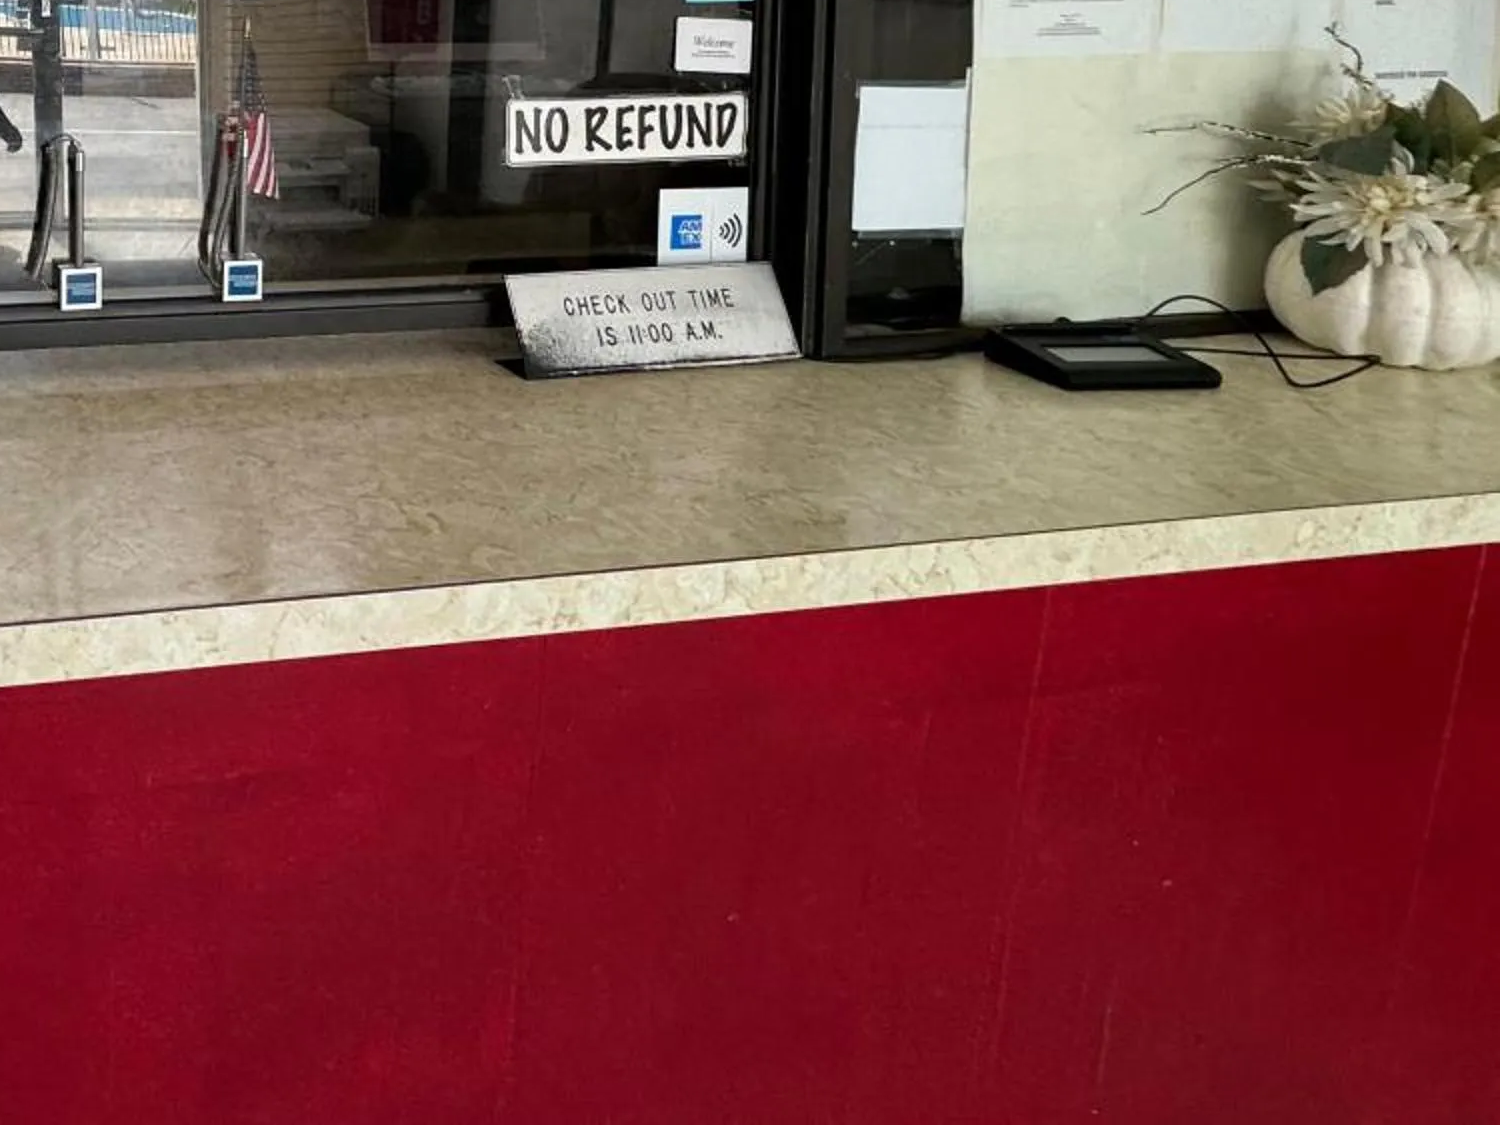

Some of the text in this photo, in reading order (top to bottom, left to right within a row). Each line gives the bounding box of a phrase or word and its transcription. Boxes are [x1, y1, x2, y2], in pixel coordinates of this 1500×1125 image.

[513, 101, 738, 155] NO REFUND
[563, 287, 735, 317] CHECK OUT TIME
[597, 320, 724, 347] IS 11:00 A.M.
